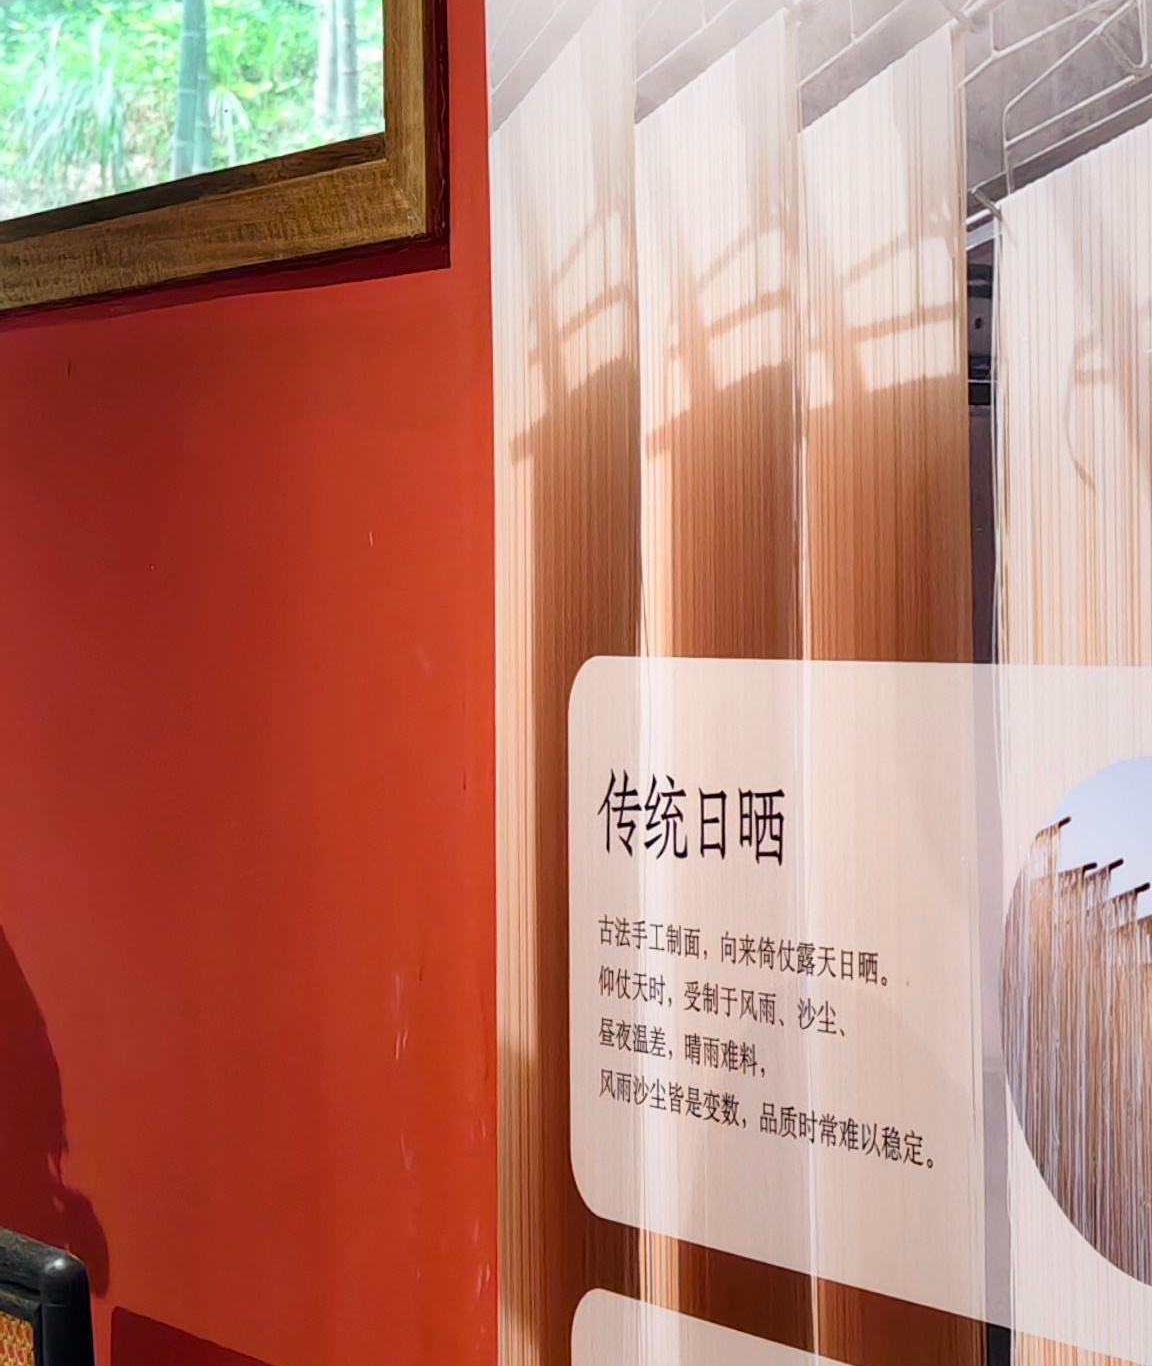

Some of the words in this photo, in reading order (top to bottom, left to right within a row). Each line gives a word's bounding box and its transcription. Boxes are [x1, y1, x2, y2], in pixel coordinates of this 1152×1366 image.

[597, 768, 786, 866] 传统日晒
[597, 914, 891, 987] 古法手工制面，向来倚仗露天日晒。
[598, 965, 846, 1036] 仰仗天时，受制于风雨、沙尘、
[599, 1017, 766, 1076] 昼夜温差，晴雨难料，
[599, 1069, 934, 1169] 风雨沙尘皆是变数，品质时常难以稳定。
